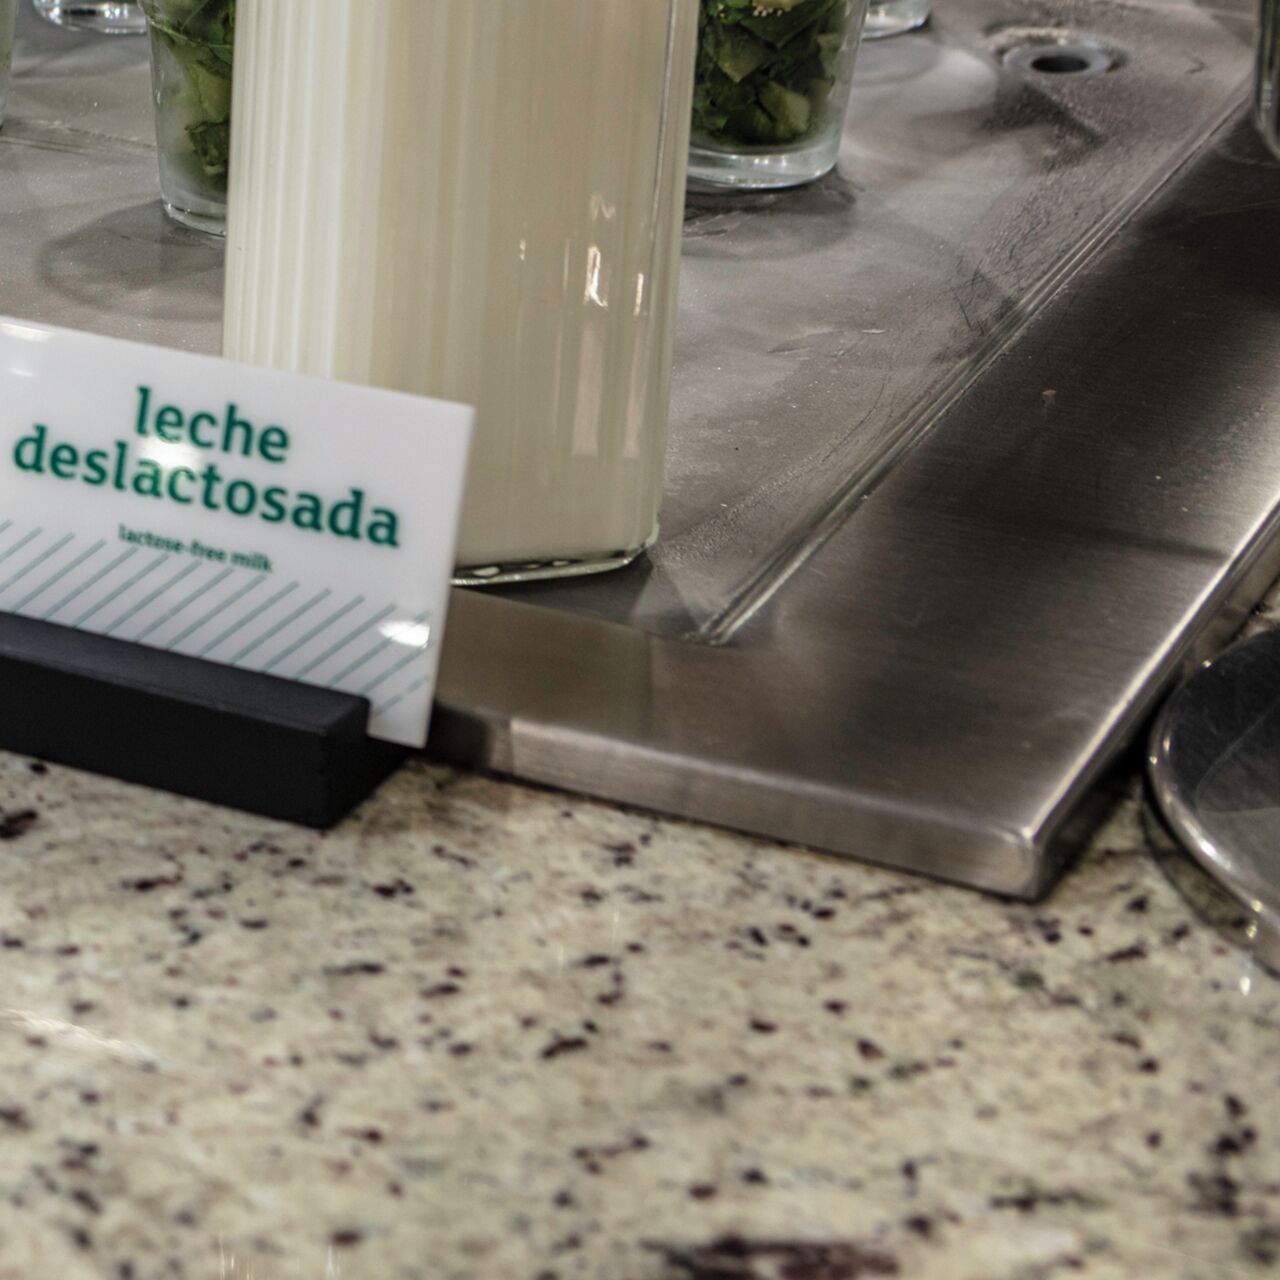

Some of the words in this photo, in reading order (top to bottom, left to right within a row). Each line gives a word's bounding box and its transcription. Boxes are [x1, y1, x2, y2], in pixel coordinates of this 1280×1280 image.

[134, 384, 292, 464] leche
[11, 423, 401, 549] deslactosada
[118, 523, 228, 564] lactose-free
[229, 547, 274, 573] milk
